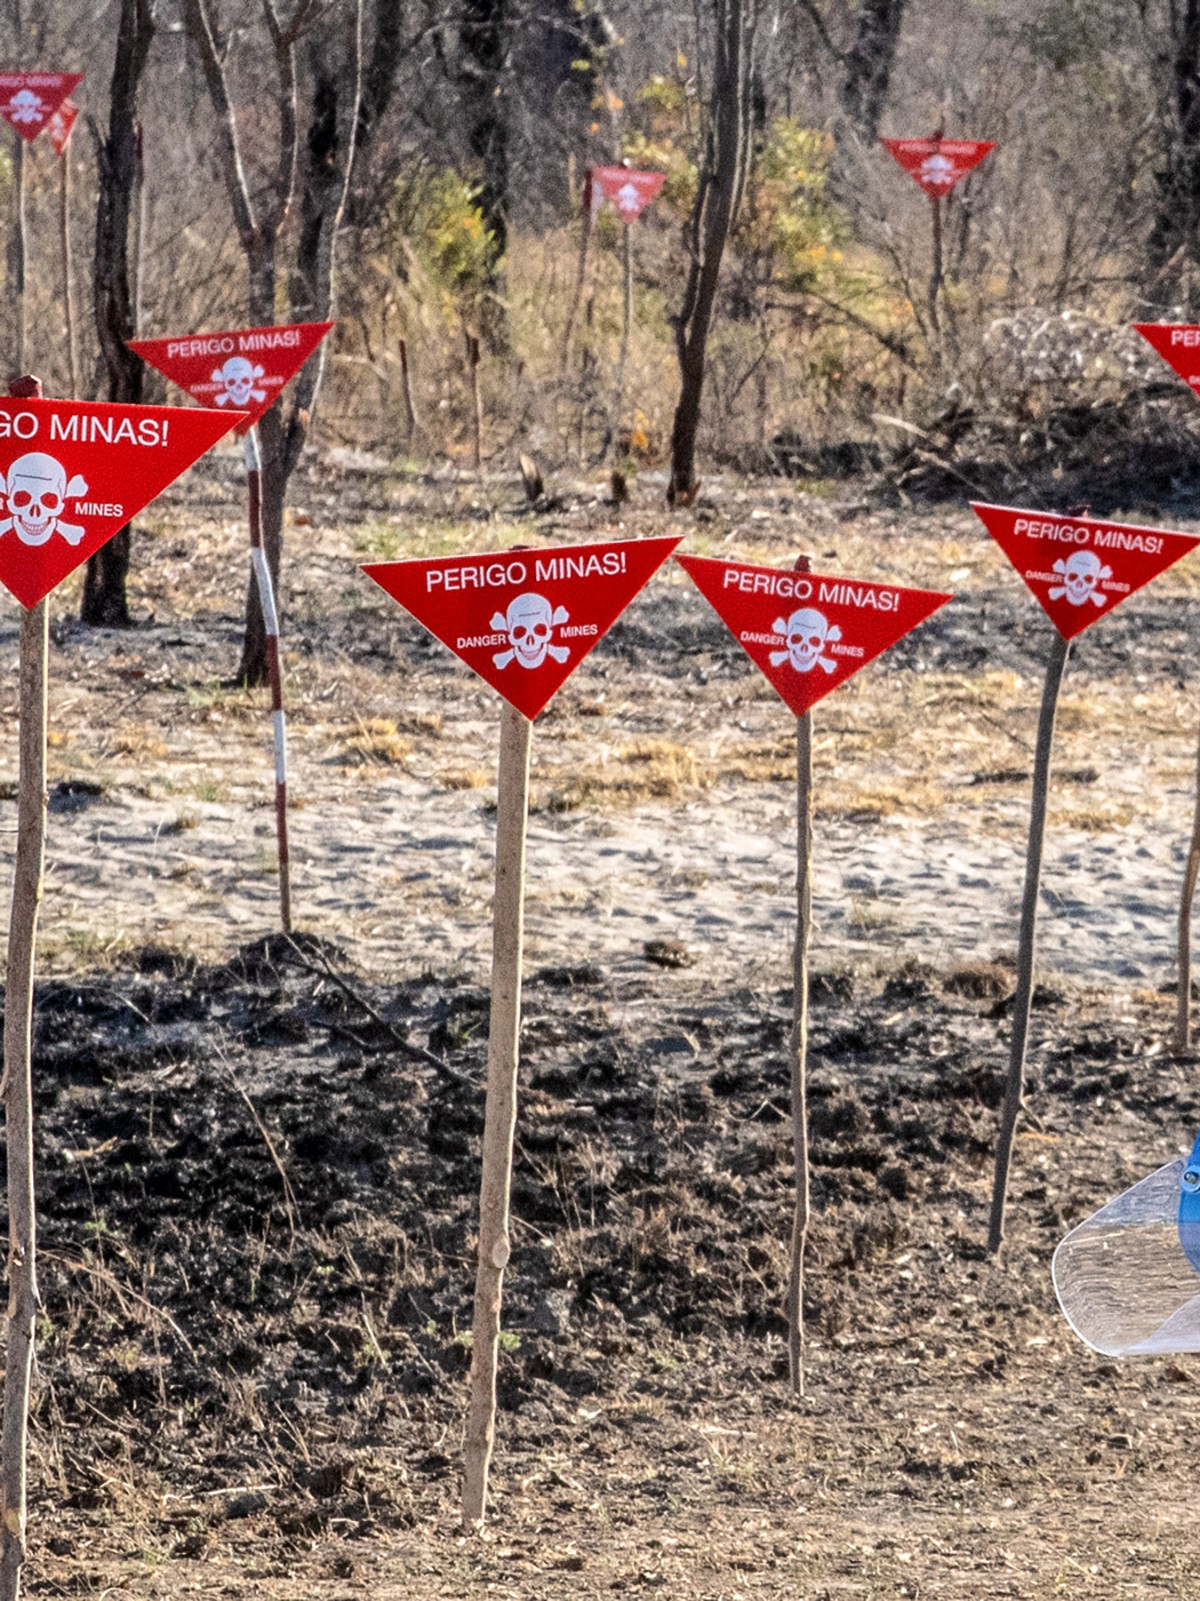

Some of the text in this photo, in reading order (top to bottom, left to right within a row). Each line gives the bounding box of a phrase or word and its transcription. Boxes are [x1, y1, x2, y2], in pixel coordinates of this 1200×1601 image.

[167, 329, 300, 359] PERIGO MINAS!
[50, 414, 169, 447] MINAS!
[74, 501, 124, 517] MINES
[1014, 518, 1164, 554] PERIGO MINAS!
[426, 551, 627, 593] PERIGO MINAS!
[723, 569, 900, 612] PERIGO MINAS!
[456, 624, 598, 649] DANGER MINES
[740, 630, 865, 658] DANGER MINES
